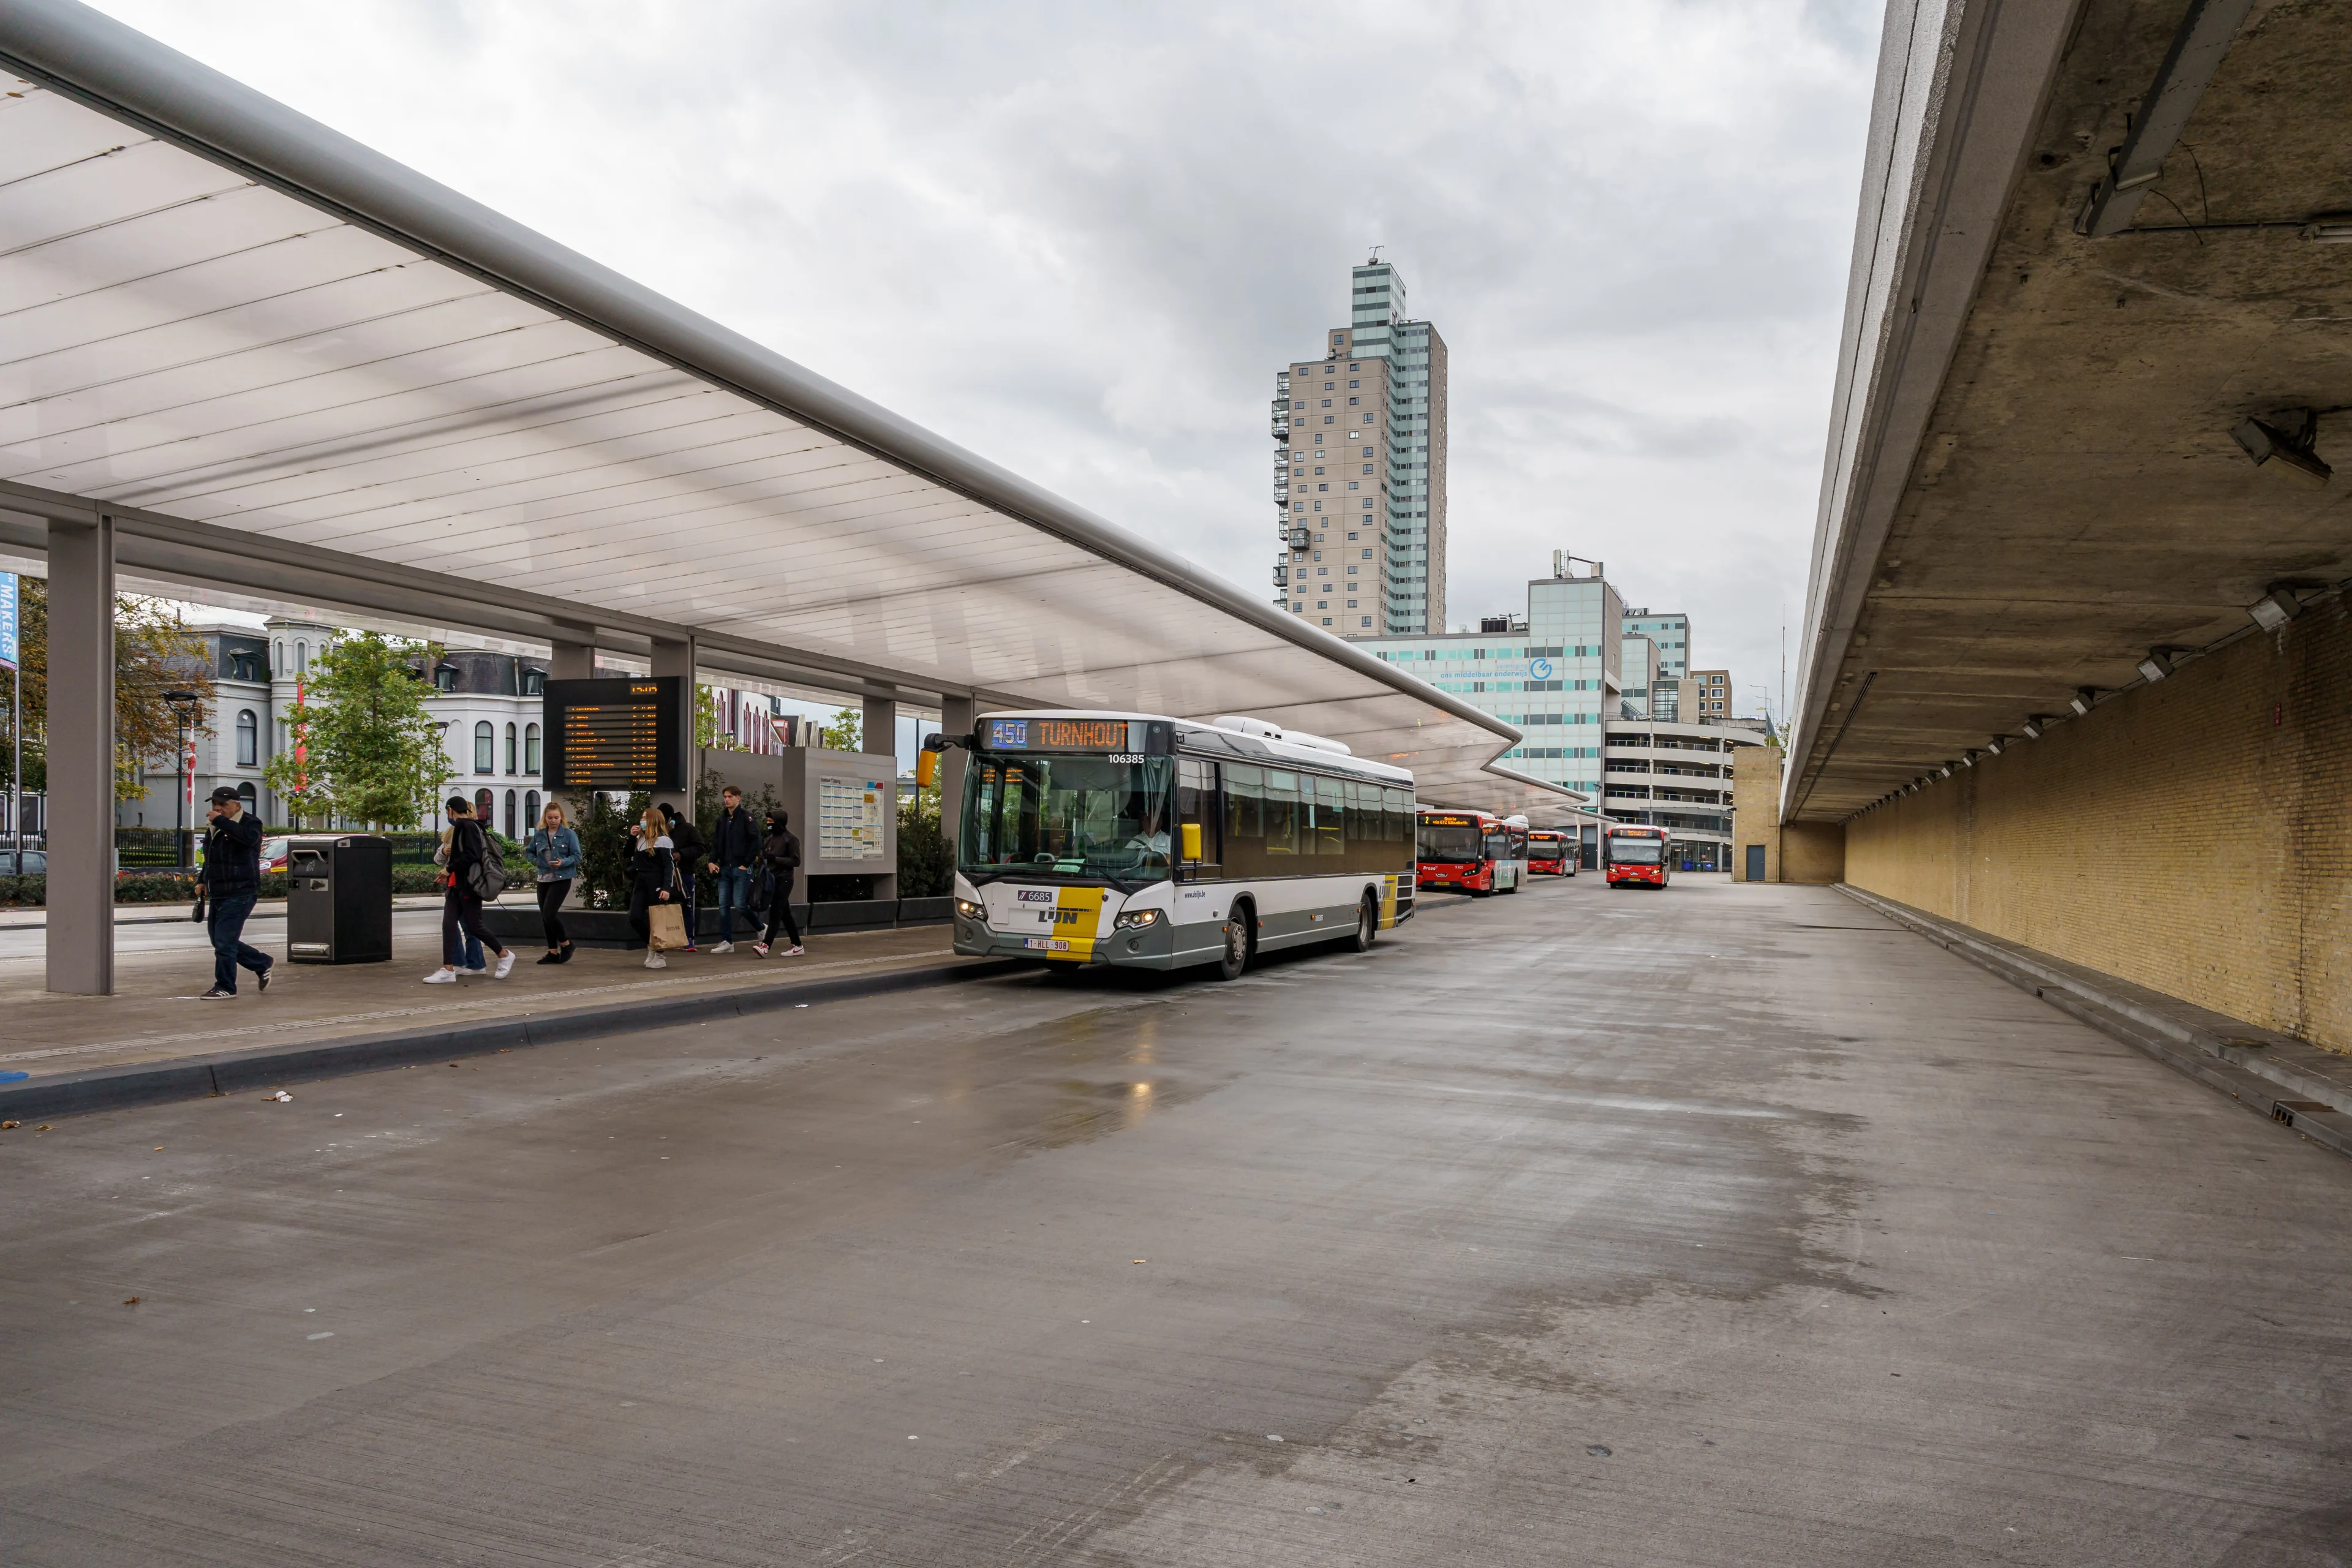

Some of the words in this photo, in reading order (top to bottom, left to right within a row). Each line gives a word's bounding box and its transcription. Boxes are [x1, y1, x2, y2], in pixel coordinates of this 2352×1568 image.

[1, 584, 13, 655] MAKERS
[993, 723, 1027, 744] 450
[1039, 722, 1128, 746] TURNHOUT
[1109, 754, 1144, 763] 106385
[1029, 892, 1050, 901] 6685
[1038, 910, 1078, 924] LIJN
